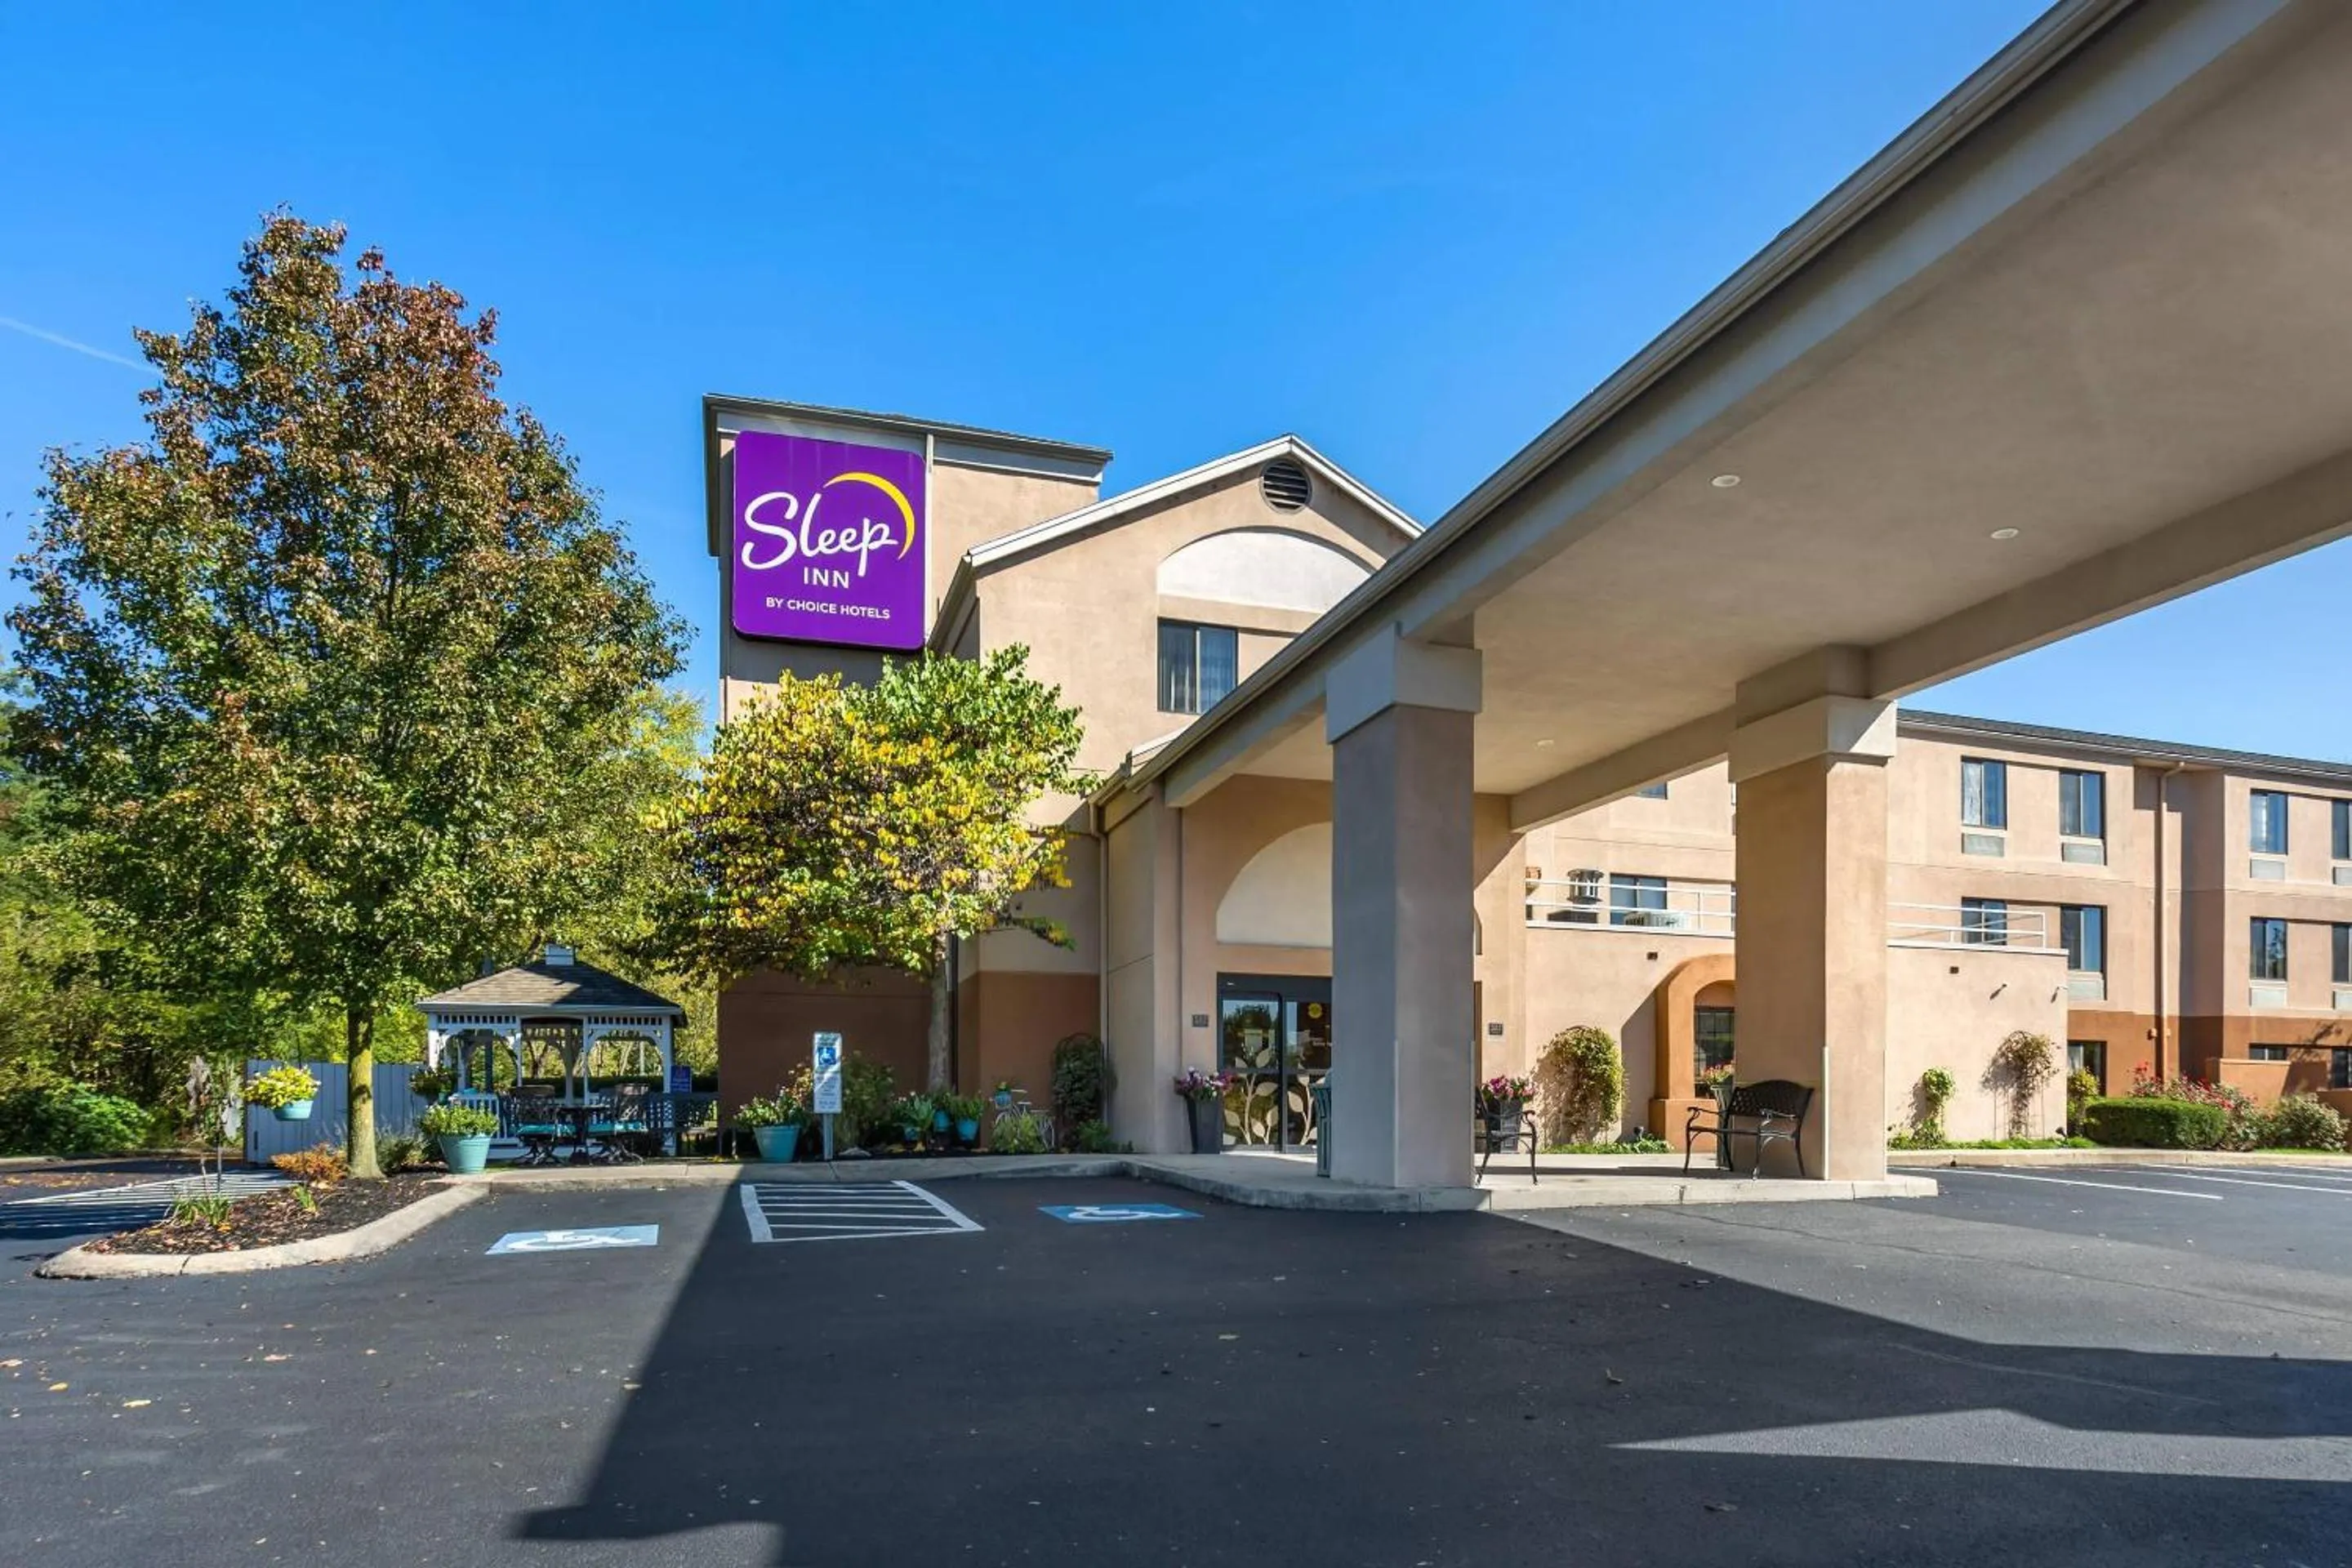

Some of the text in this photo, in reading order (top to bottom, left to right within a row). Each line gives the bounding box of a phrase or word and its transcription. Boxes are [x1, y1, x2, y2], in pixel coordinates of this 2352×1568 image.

[742, 492, 898, 577] Sleep
[804, 567, 849, 588] INN
[766, 597, 890, 619] BY CHOICE HOTELS
